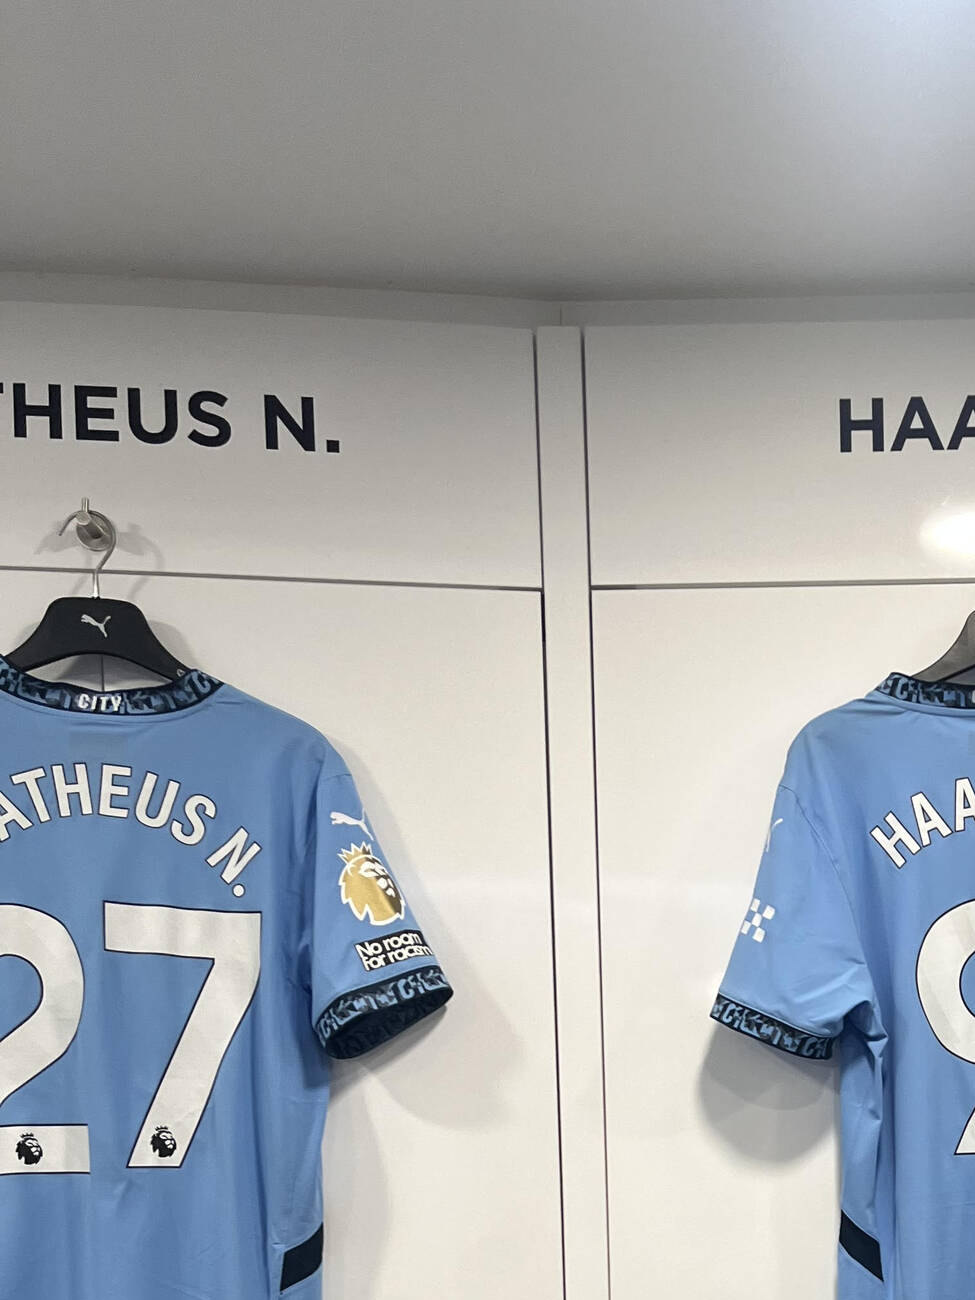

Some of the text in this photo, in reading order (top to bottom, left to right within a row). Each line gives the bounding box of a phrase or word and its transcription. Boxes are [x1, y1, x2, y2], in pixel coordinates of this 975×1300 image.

[0, 382, 340, 453] HEUS N.
[77, 692, 122, 712] CITY
[205, 826, 262, 897] N.
[355, 932, 422, 957] No room
[361, 945, 433, 971] for racism
